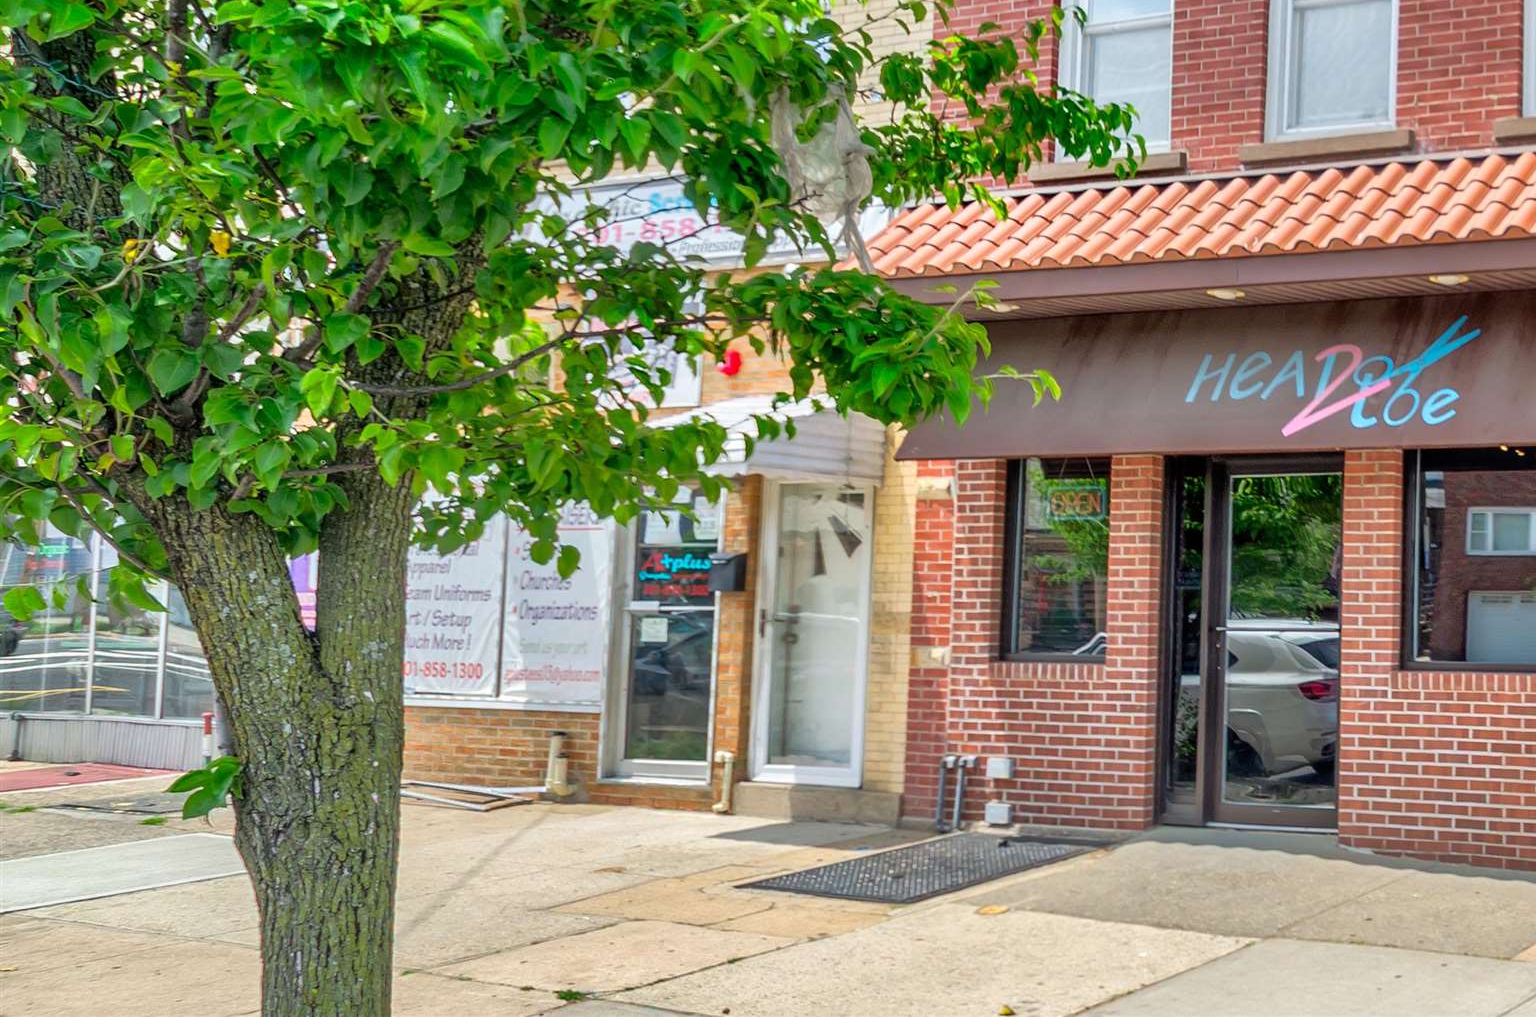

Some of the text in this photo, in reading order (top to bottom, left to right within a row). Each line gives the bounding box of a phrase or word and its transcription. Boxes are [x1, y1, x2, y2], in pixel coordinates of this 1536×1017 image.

[1051, 491, 1101, 516] OPEN
[407, 558, 451, 580] pparel
[405, 584, 492, 602] eam Uniforms
[431, 609, 472, 633] Setup
[519, 599, 598, 626] Organizations
[403, 661, 483, 679] 01-858-1300
